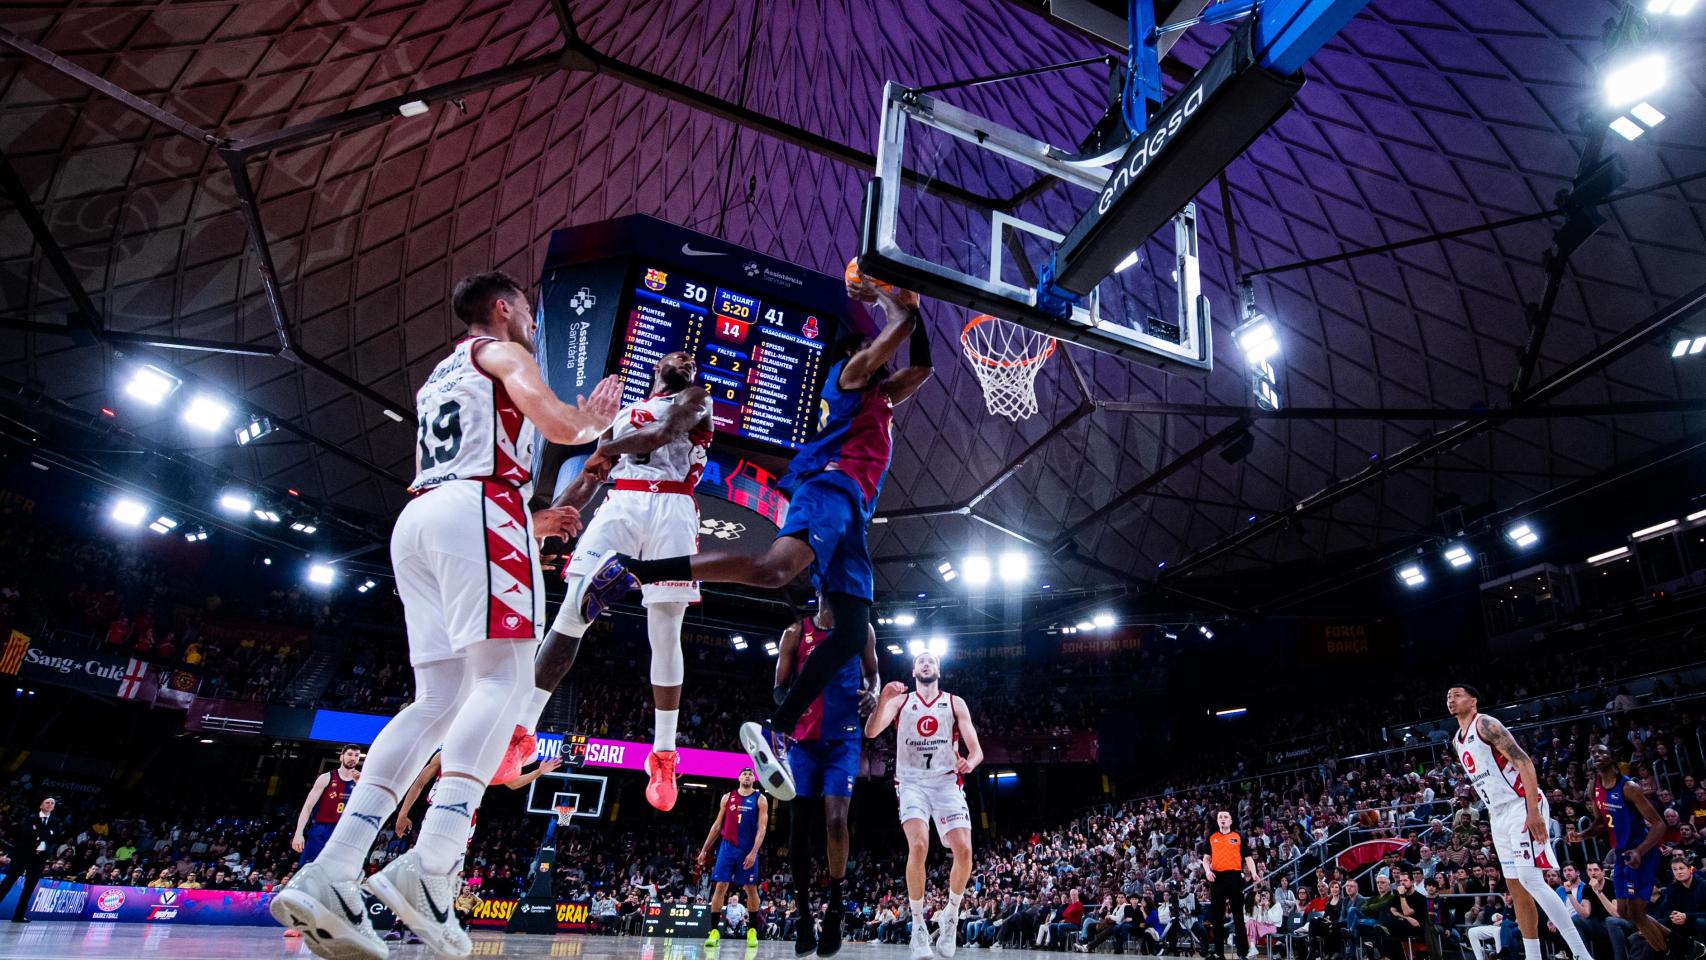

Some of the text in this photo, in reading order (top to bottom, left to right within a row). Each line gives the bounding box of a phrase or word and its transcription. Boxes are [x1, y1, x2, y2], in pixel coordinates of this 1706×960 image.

[1099, 83, 1203, 214] endesa
[684, 283, 707, 302] 30
[732, 295, 754, 306] QUART
[642, 306, 666, 317] PUNTER
[722, 301, 750, 318] 5:20
[640, 314, 672, 327] ANDERSON
[765, 309, 784, 326] 41
[639, 322, 655, 330] SARR
[722, 322, 740, 338] 14
[637, 330, 665, 342] BRIZUELA
[567, 322, 580, 368] Sanitària
[766, 342, 785, 352] SPISSU
[576, 321, 590, 386] Assistència
[633, 346, 664, 358] SATORANS
[764, 350, 798, 364] BELL-HAYNES
[710, 355, 740, 371] 2 2
[762, 364, 778, 374] YUSTA
[763, 358, 793, 370] SLAUGHTER
[626, 377, 650, 388] PARKER
[704, 375, 721, 383] TEMPS
[760, 372, 787, 384] GONZÁLEZ
[625, 385, 644, 395] PARRA
[758, 380, 780, 390] WATSON
[705, 384, 734, 399] 2 0
[757, 387, 788, 400] FERNÁNDEZ
[754, 402, 782, 414] DUBLJEVIC
[751, 417, 774, 428] MORENO
[752, 410, 792, 425] SULEJMANOVIC
[749, 425, 769, 434] MUÑOZ
[419, 400, 461, 472] 19
[25, 648, 124, 680] Sang Culé
[923, 753, 932, 768] 7
[337, 802, 344, 813] 8
